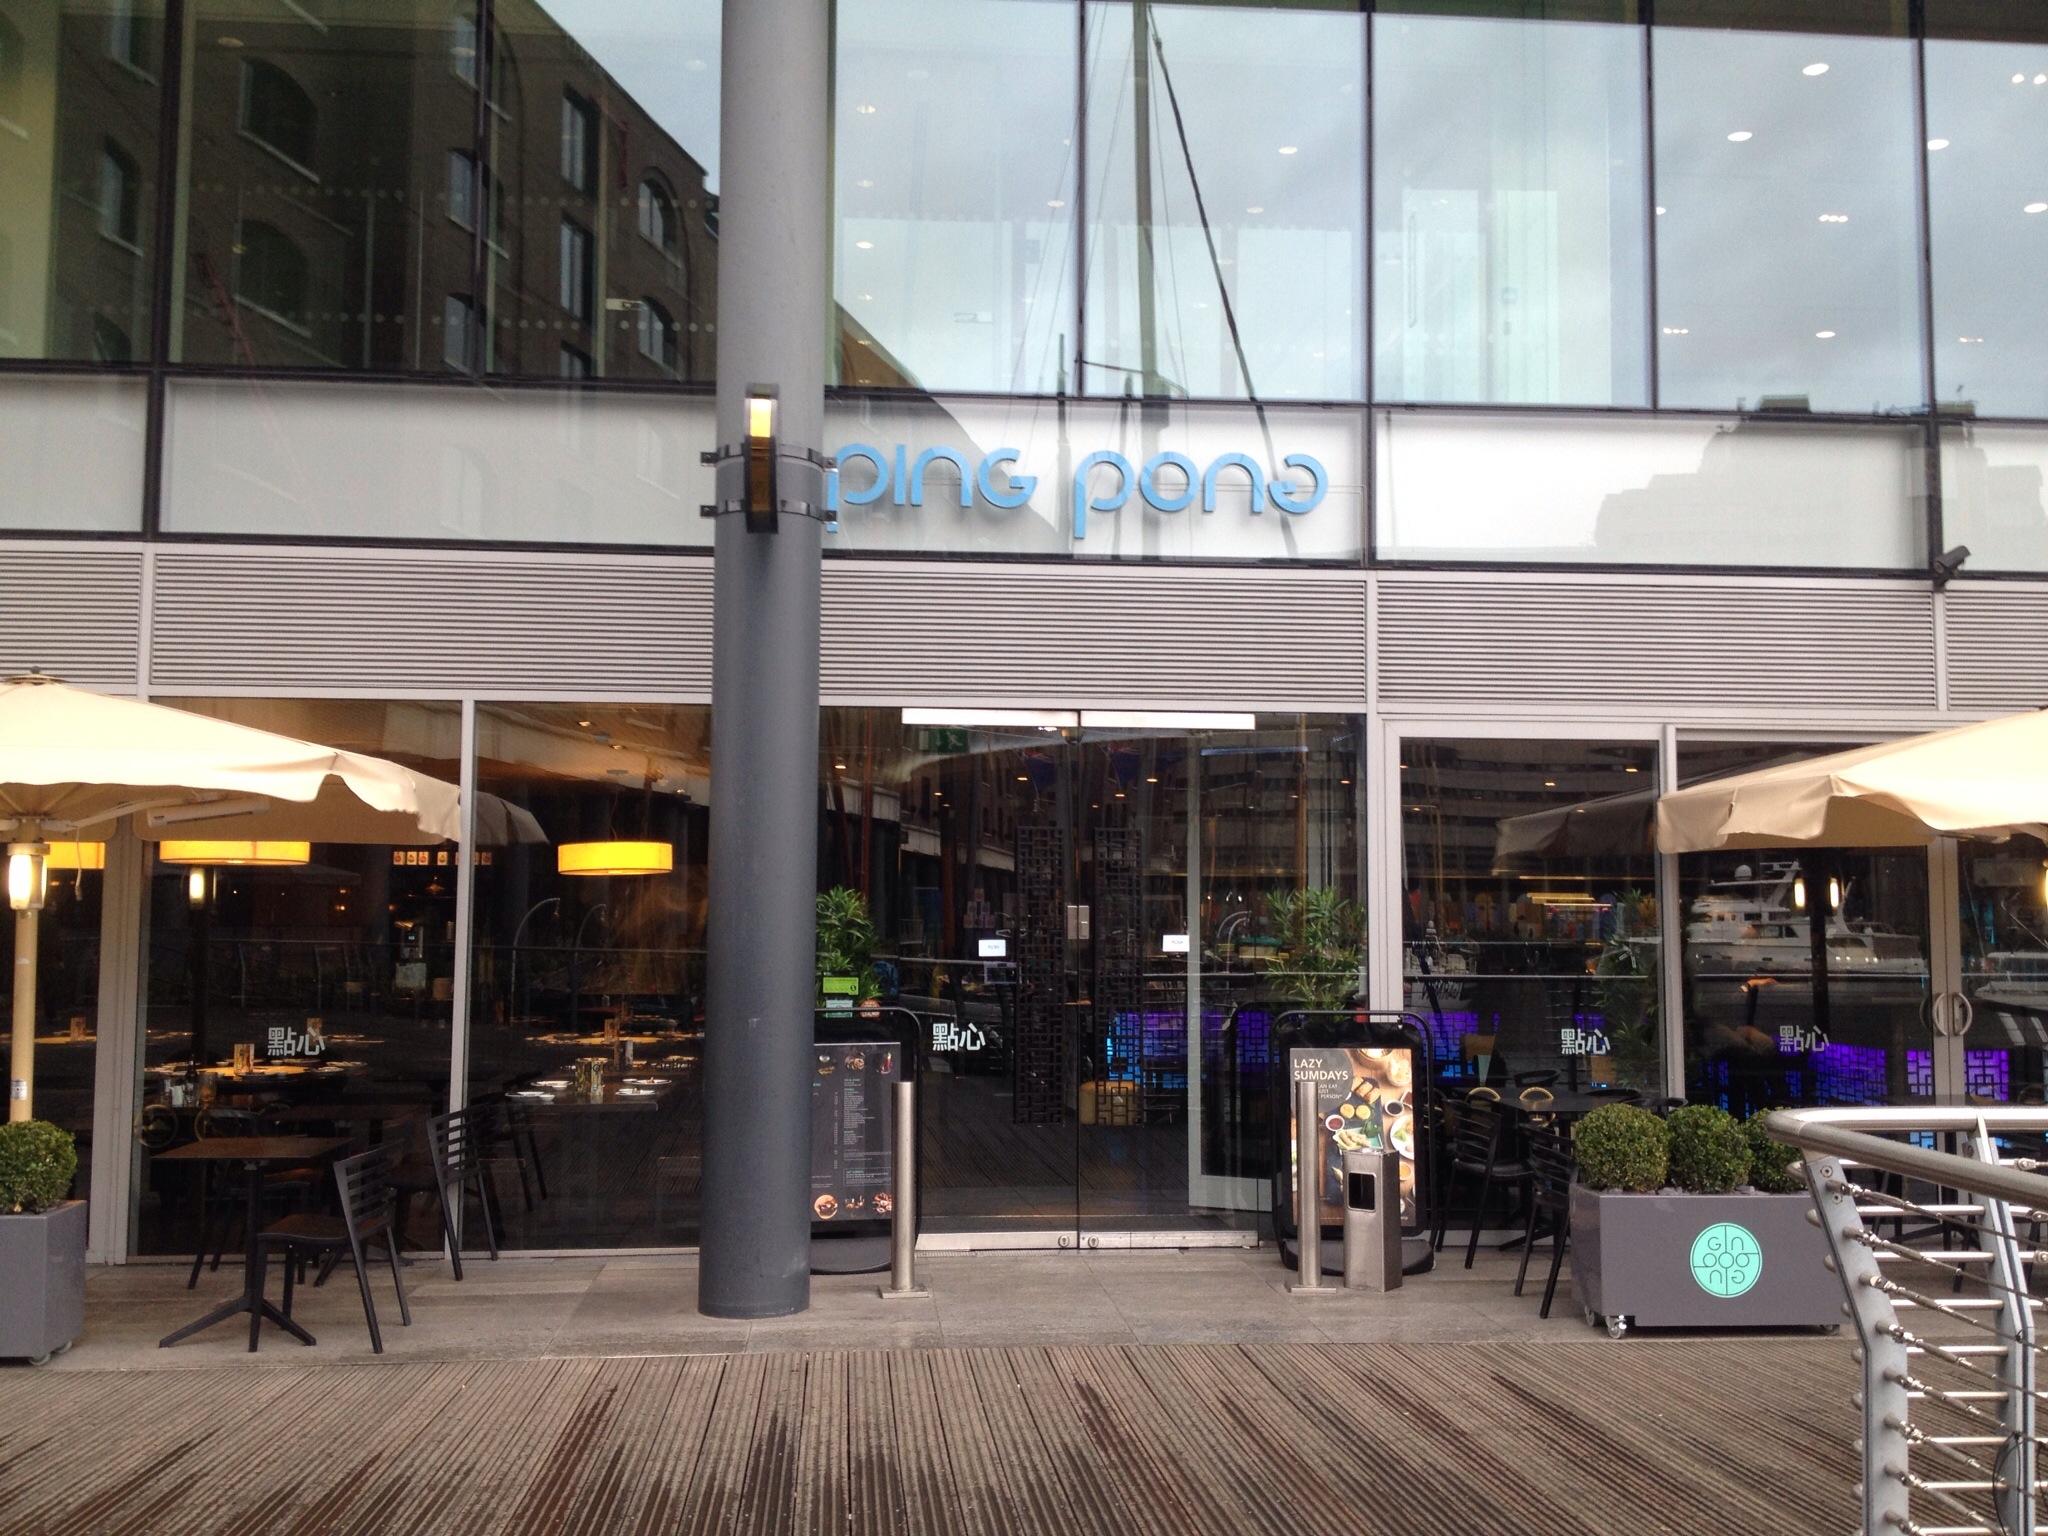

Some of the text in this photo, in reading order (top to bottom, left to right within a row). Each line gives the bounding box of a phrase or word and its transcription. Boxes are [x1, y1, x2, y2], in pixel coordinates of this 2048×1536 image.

[267, 1026, 326, 1056] 點心
[932, 1022, 986, 1051] 點心
[1560, 1028, 1611, 1055] 點心
[1779, 1025, 1830, 1052] 點心
[1293, 1058, 1323, 1069] LAZY
[1293, 1070, 1349, 1080] SUMDAYS
